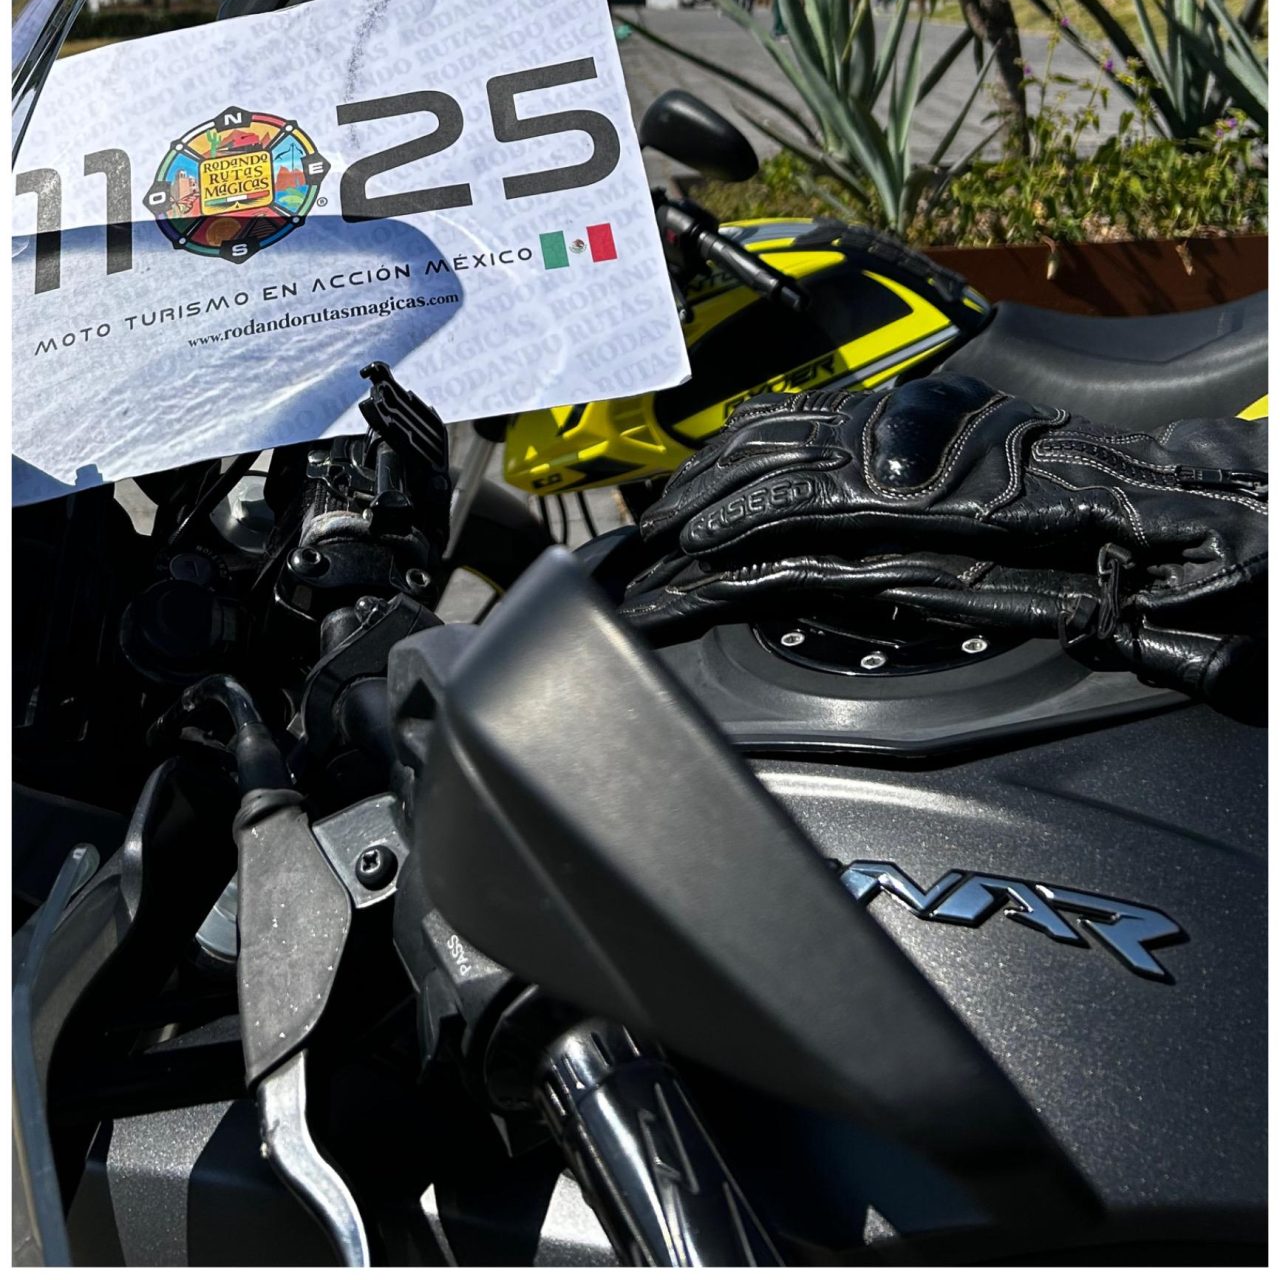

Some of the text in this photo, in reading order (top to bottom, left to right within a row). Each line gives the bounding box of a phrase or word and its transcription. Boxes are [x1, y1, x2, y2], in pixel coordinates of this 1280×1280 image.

[223, 112, 243, 126] N
[337, 57, 621, 224] 25
[308, 161, 324, 174] E
[231, 244, 249, 256] S
[34, 247, 533, 356] MOTO TURISMO EN ACCIÓN MÉXICO
[188, 292, 459, 349] www.rodandorutasmagicas.com
[446, 934, 472, 976] PASS
